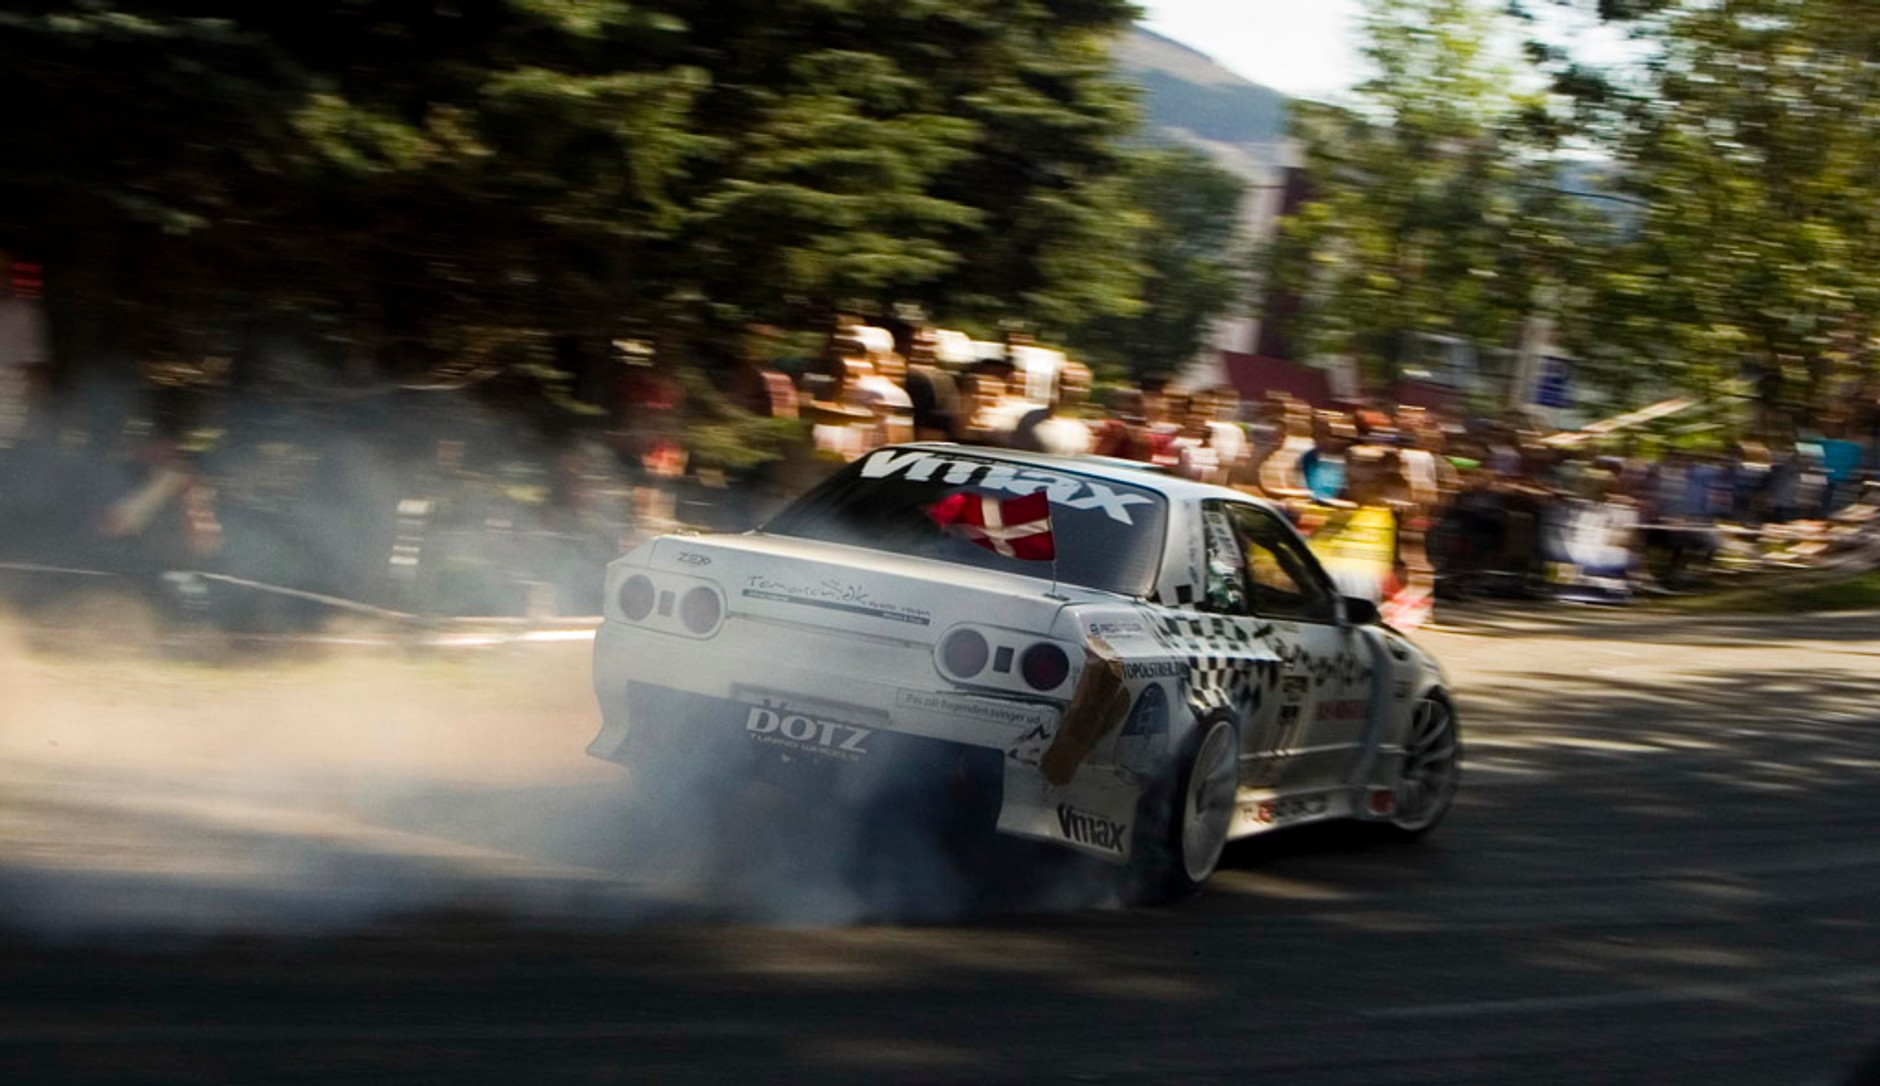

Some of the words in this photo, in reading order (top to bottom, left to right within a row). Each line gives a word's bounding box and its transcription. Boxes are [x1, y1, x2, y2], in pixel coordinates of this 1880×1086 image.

[860, 450, 1154, 526] Vmax
[745, 706, 872, 754] DOTZ
[1056, 803, 1127, 853] Vmax
